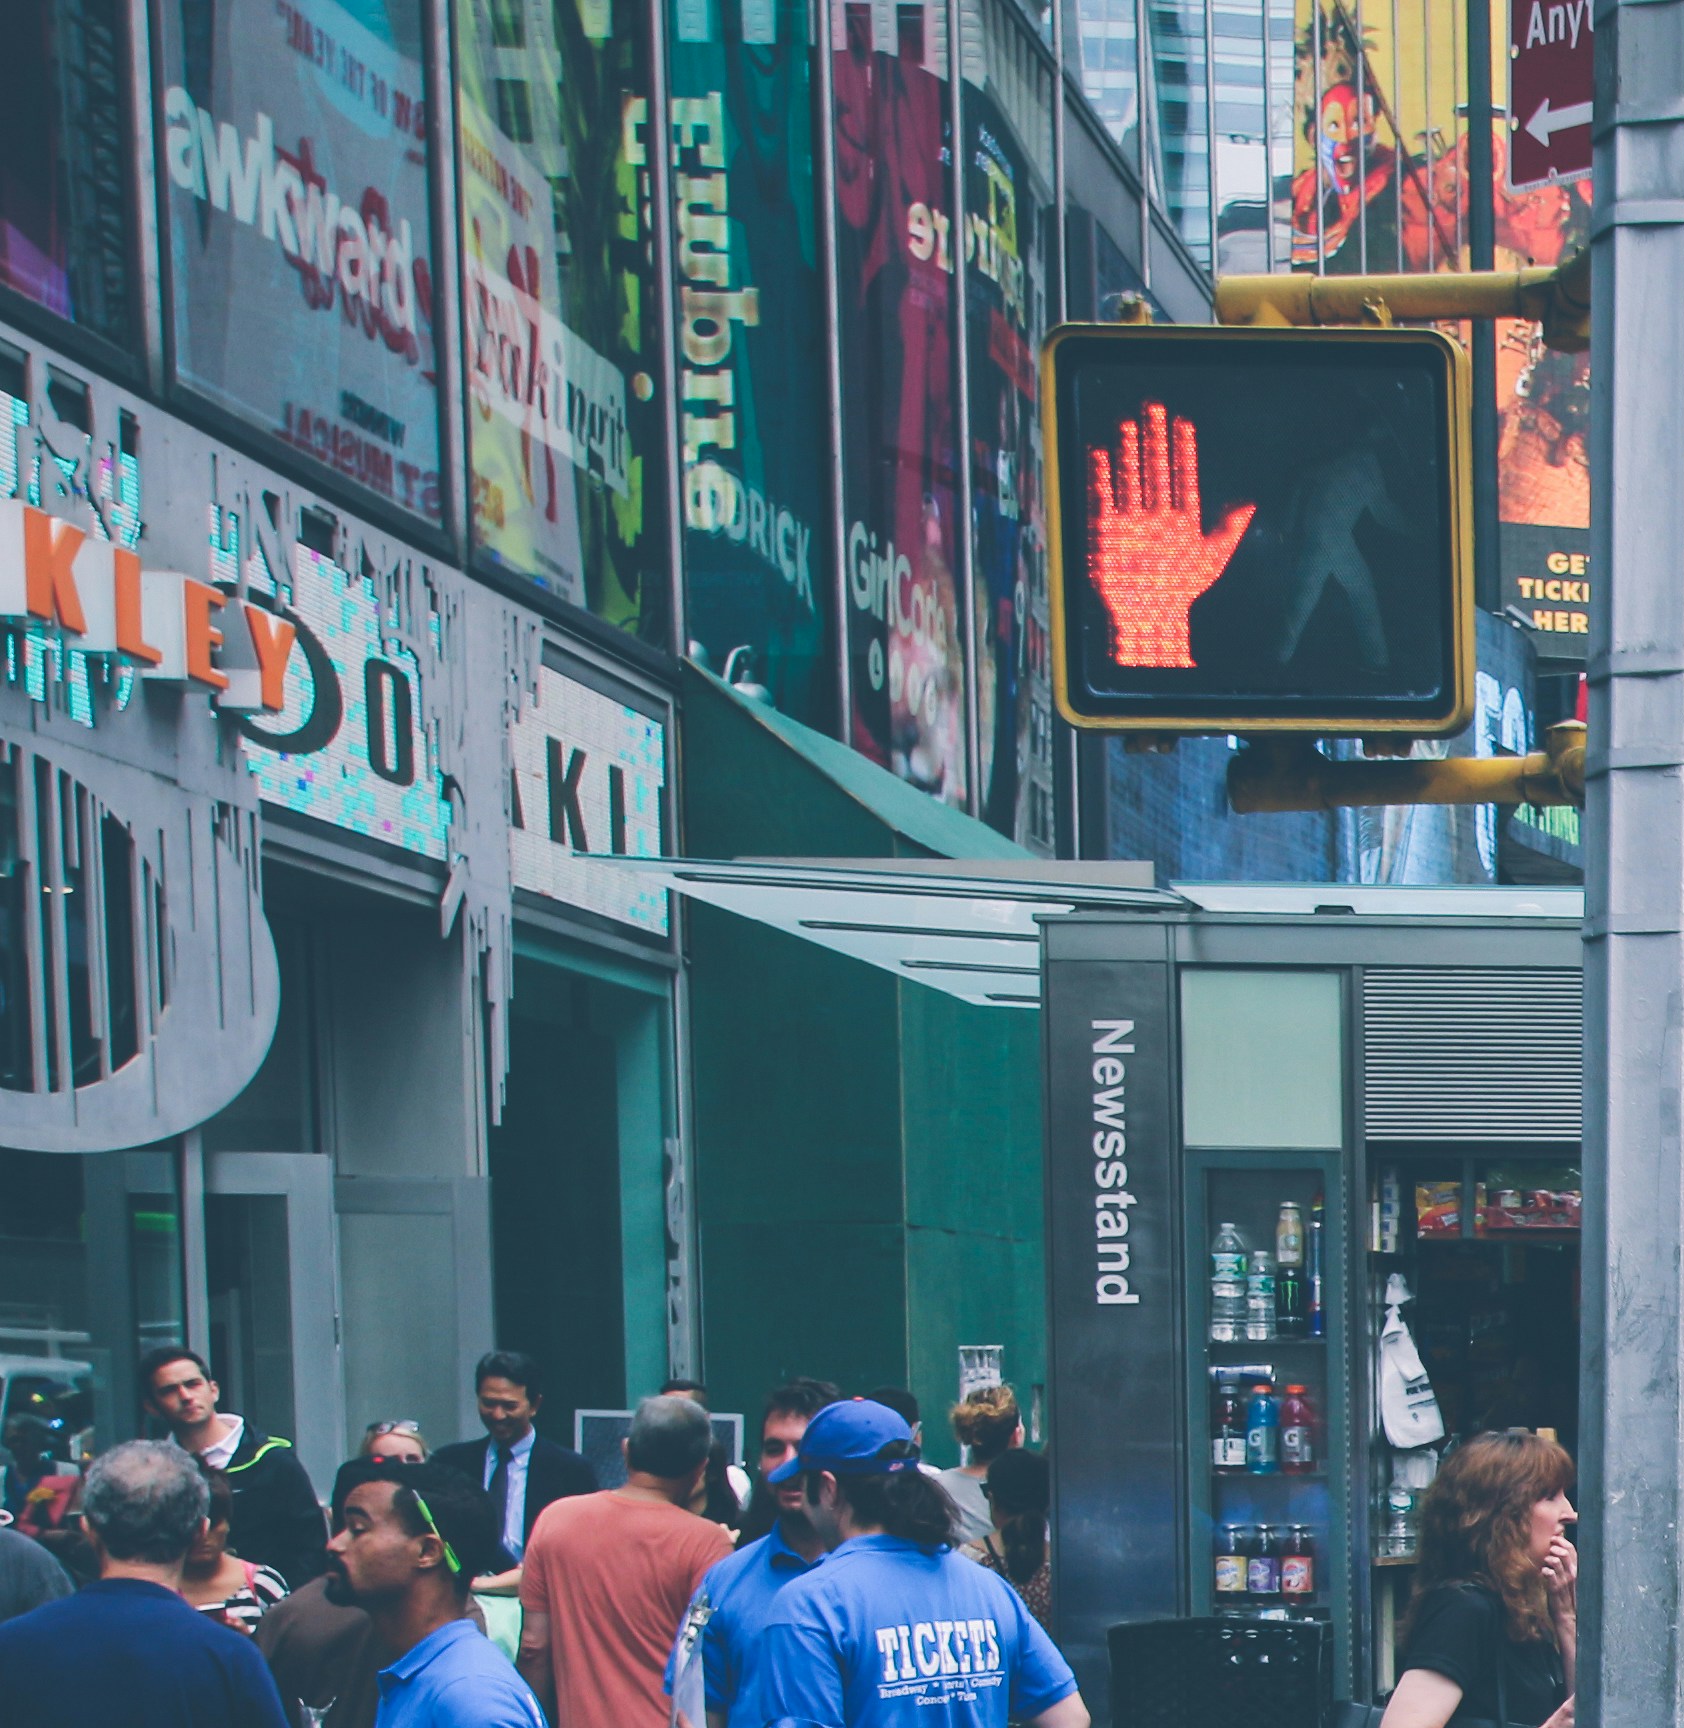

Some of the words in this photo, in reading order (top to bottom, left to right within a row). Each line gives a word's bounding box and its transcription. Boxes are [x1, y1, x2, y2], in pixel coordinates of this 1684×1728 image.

[1546, 550, 1592, 576] GE
[1090, 1017, 1140, 1307] Newsstand
[875, 1616, 1001, 1683] TICKETS
